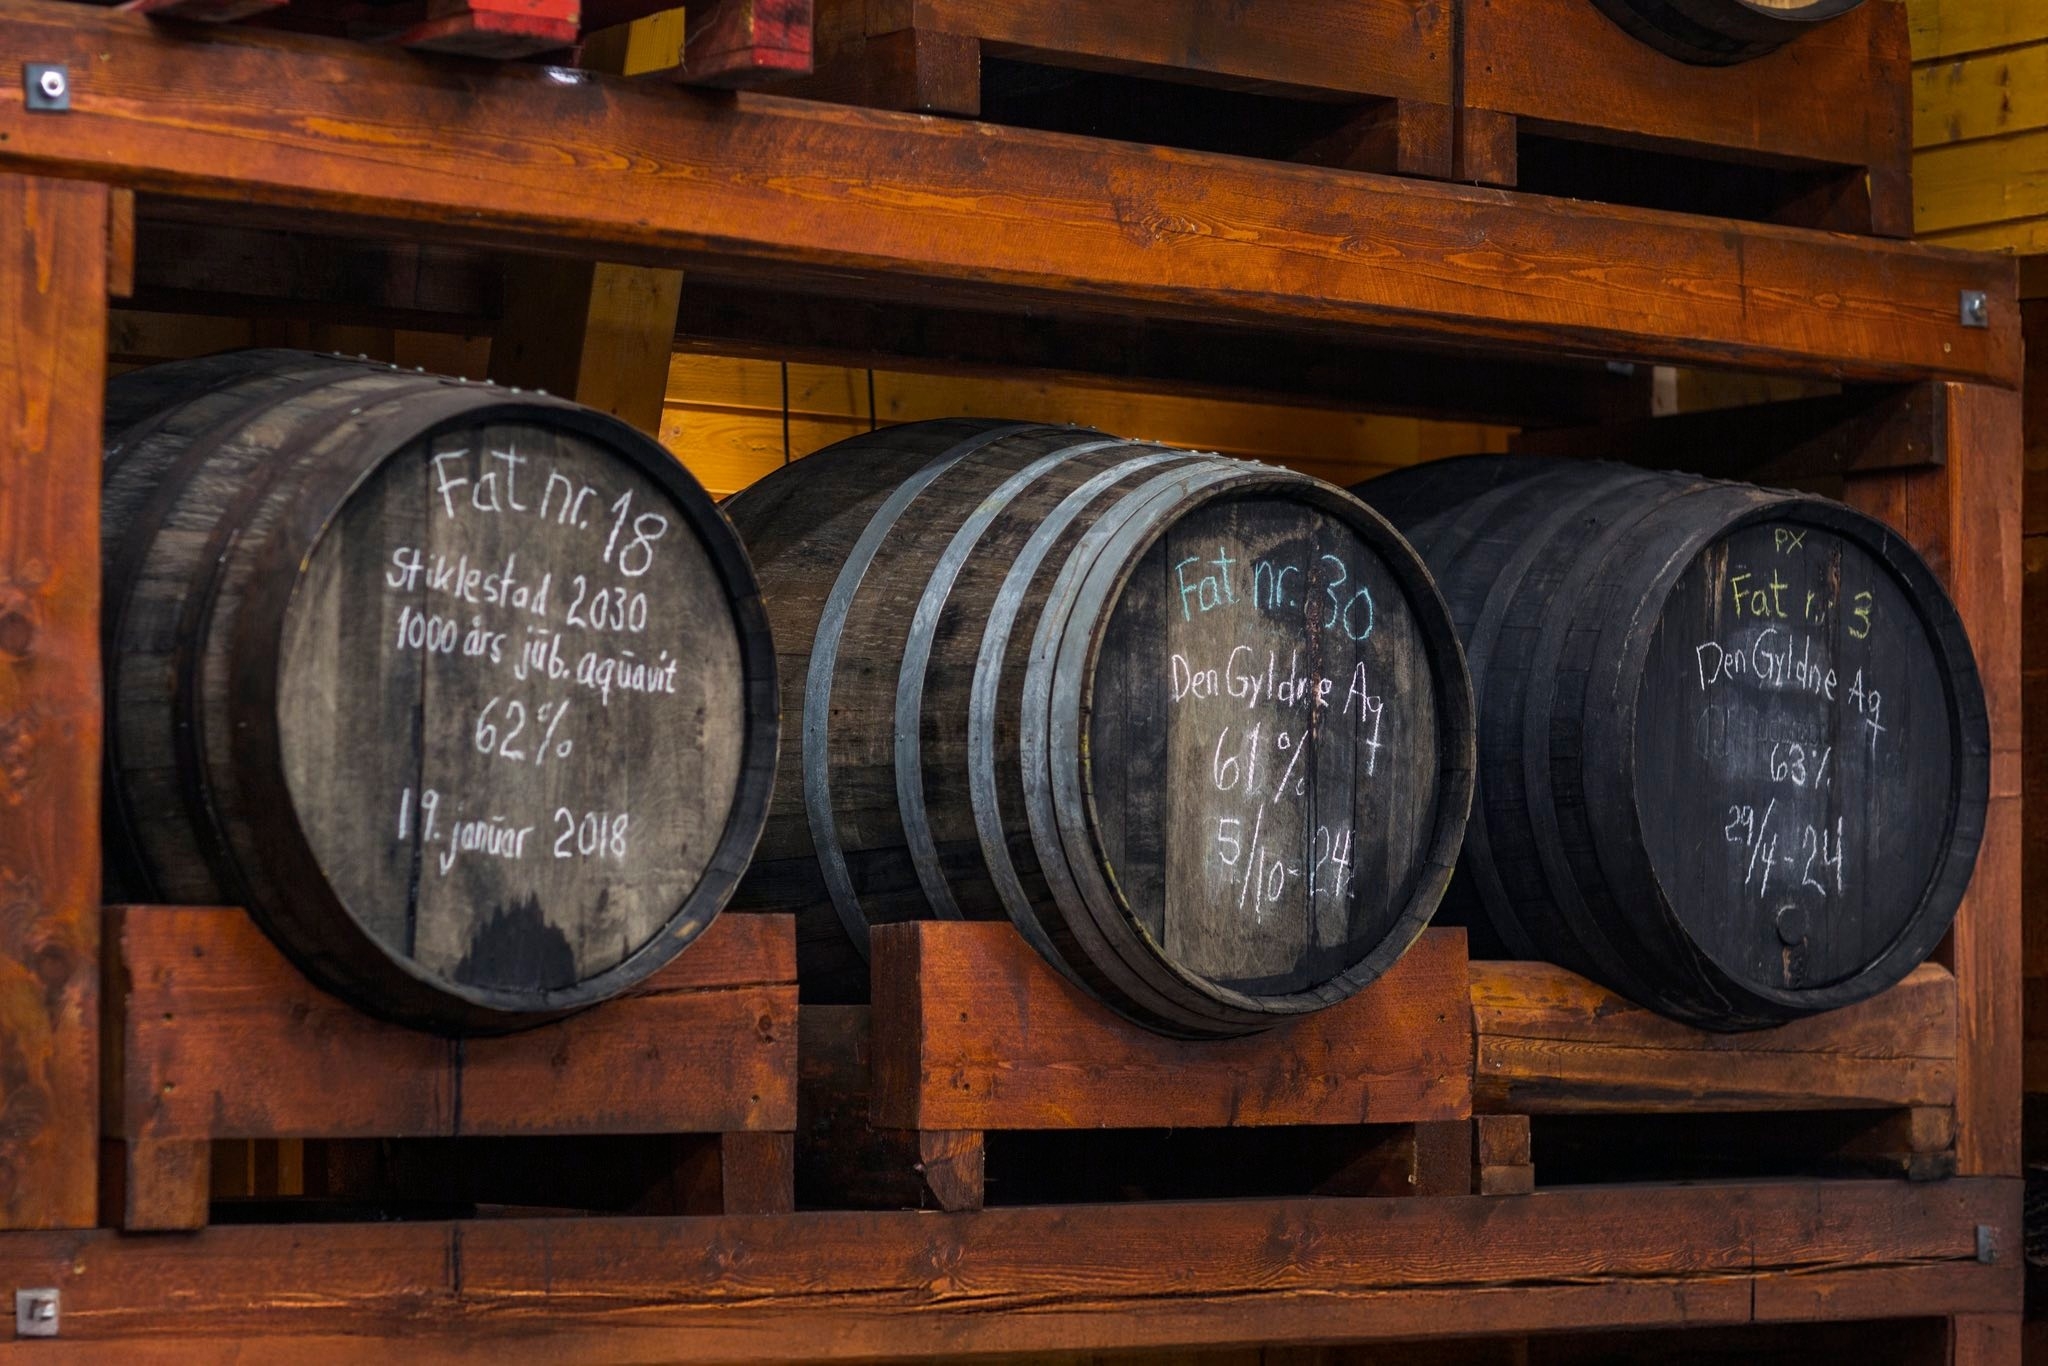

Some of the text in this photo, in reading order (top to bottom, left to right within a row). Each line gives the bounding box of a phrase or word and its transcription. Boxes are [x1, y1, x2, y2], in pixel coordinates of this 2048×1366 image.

[430, 444, 668, 576] Fat nr. 18
[386, 547, 648, 632] Stiklestad 2030
[1175, 546, 1374, 640] Fat nr. 30
[1731, 568, 1788, 619] Fat
[1848, 591, 1873, 639] 3
[397, 606, 457, 654] 1000
[463, 615, 506, 663] års
[1696, 642, 1746, 690] Den
[1752, 628, 1838, 700] Gyldne
[1171, 654, 1219, 702] Den
[475, 697, 572, 766] 62%
[1214, 721, 1308, 803] 61%
[554, 807, 629, 860] 2018
